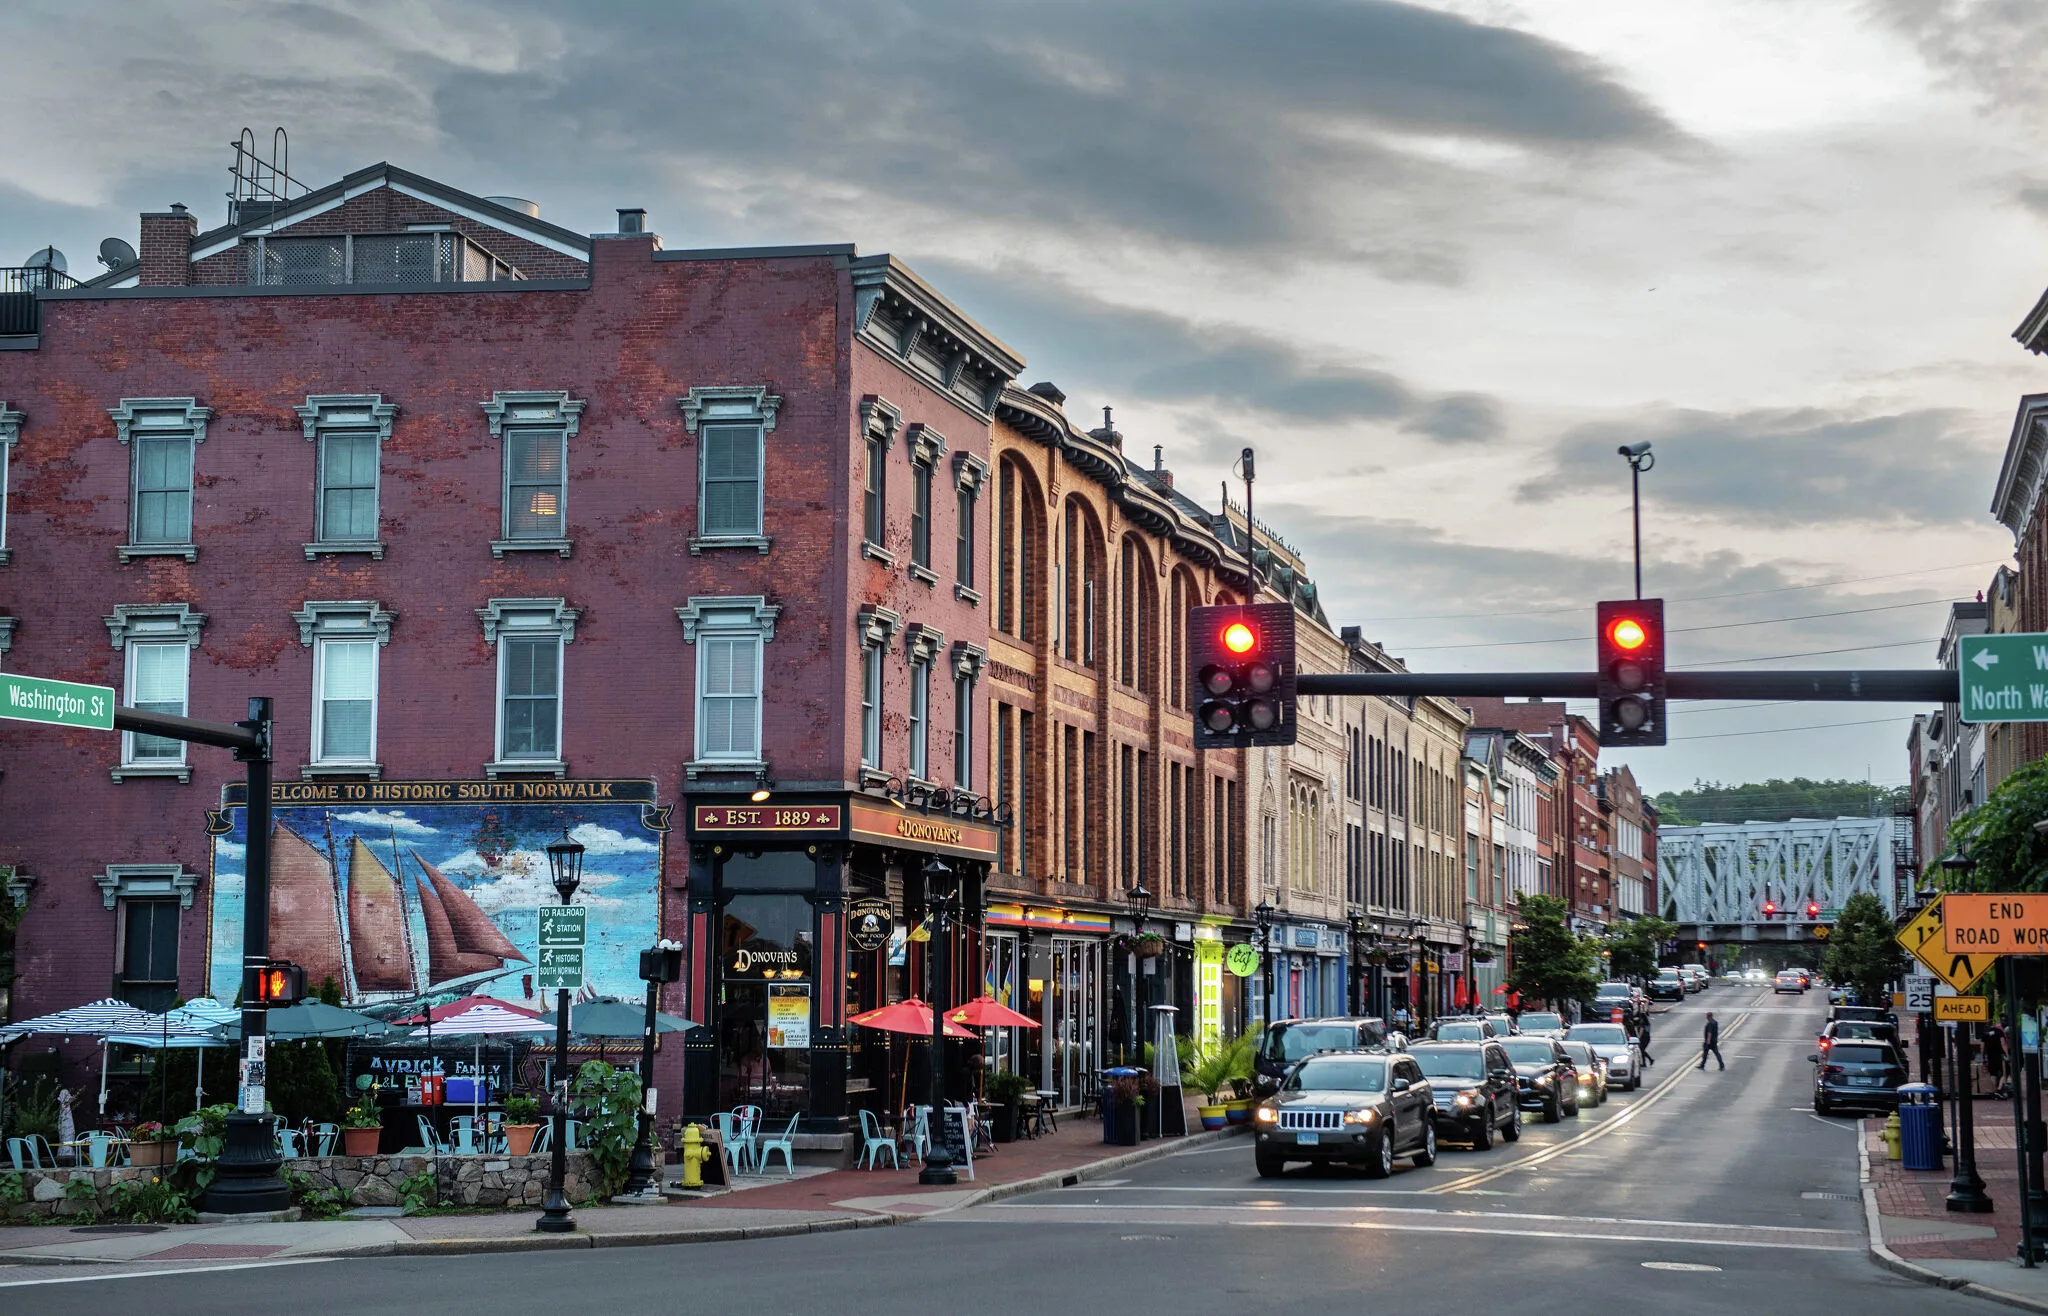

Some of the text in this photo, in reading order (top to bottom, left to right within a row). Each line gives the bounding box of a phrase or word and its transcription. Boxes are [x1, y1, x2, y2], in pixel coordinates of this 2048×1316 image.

[9, 684, 104, 718] Washington St
[1971, 685, 2023, 710] North
[272, 783, 613, 799] ELCOME TO HISTORIC SOUTH NORWALK
[726, 810, 811, 825] EST. 1889
[904, 820, 957, 843] DONOVAN'S
[552, 908, 584, 917] RAILROAD
[1990, 903, 2024, 919] END
[556, 924, 581, 932] STATION
[1956, 928, 2000, 944] ROAD
[555, 954, 580, 963] HISTORIC
[736, 949, 798, 972] DONOVAN'S
[540, 966, 581, 975] SOUTH NORWALK
[1909, 994, 1932, 1007] 25
[1942, 1004, 1981, 1014] AHEAD
